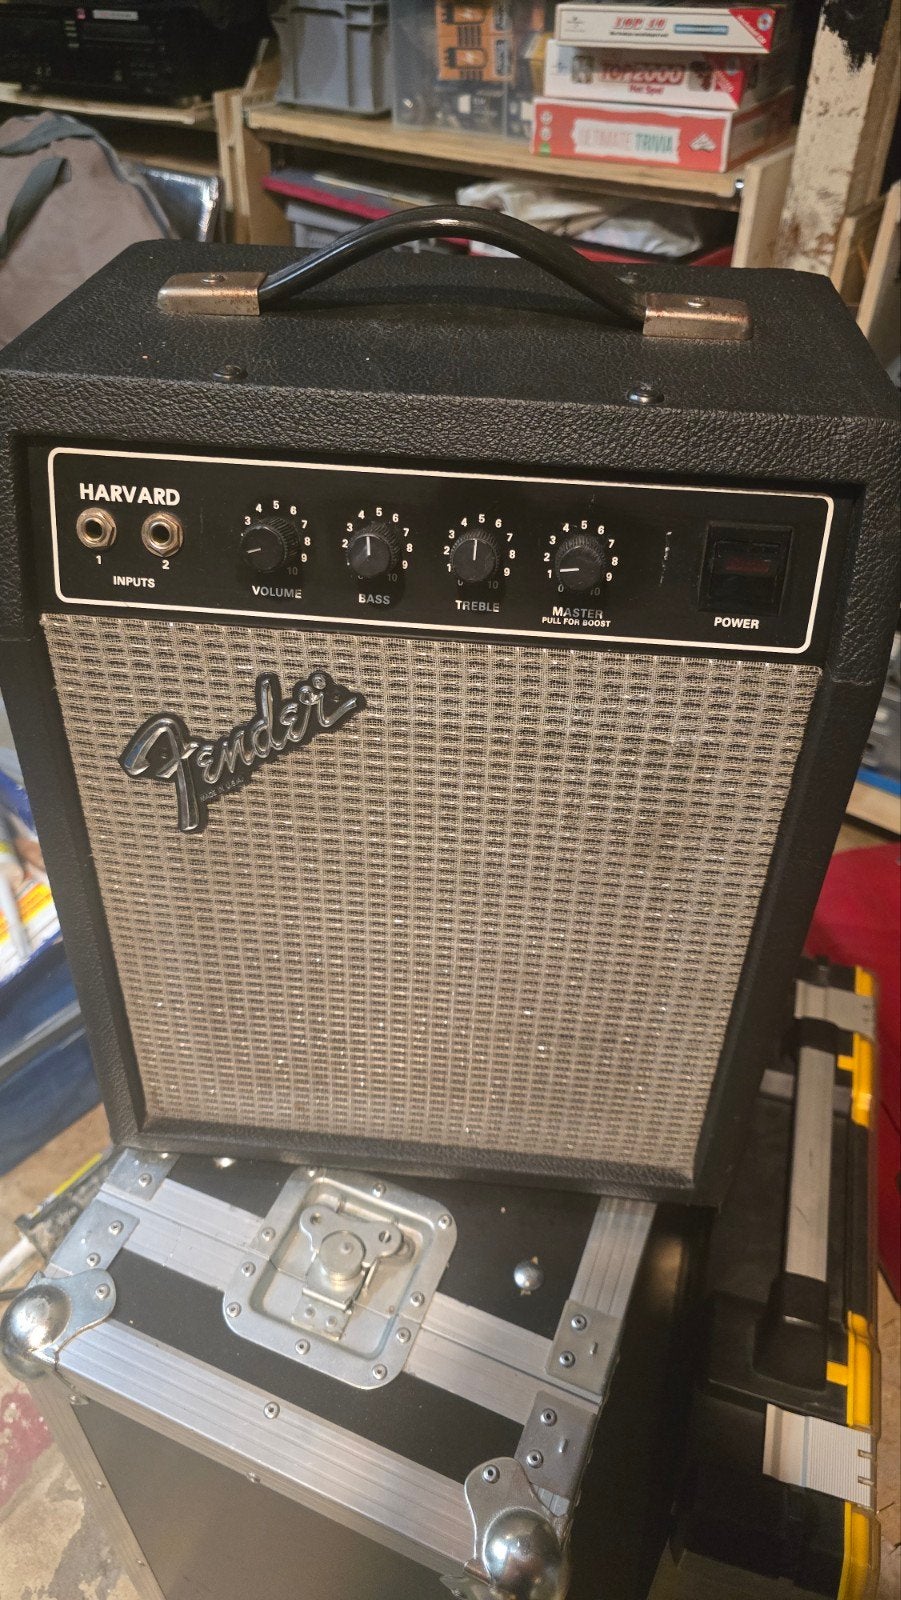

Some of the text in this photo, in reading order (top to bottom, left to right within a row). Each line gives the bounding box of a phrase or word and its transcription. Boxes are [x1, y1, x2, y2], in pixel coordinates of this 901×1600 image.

[79, 482, 181, 506] HARVARD
[460, 517, 468, 527] 4
[478, 514, 486, 523] 5
[495, 519, 502, 529] 6
[562, 523, 570, 533] 4
[581, 520, 588, 530] 5
[448, 529, 455, 539] 3
[597, 525, 605, 535] 6
[244, 500, 311, 576] 3 4 5 6 7 8 9 10
[506, 533, 513, 542] 7
[549, 535, 557, 545] 3
[341, 507, 413, 582] 2 3 4 5 6 7 8 9 10
[608, 539, 615, 549] 7
[443, 545, 450, 555] 2
[509, 550, 516, 559] 8
[96, 555, 102, 565] 1
[543, 552, 551, 562] 2
[611, 557, 619, 566] 8
[162, 560, 170, 570] 2
[503, 567, 511, 577] 9
[547, 570, 552, 579] 1
[606, 572, 613, 582] 9
[113, 575, 156, 588] INPUTS
[488, 580, 499, 590] 10
[251, 585, 302, 599] VOLUME
[557, 583, 565, 593] 0
[358, 593, 391, 605] BASS
[455, 600, 500, 613] TREBLE
[552, 606, 603, 619] MASTER
[542, 616, 611, 628] PULL FOR BOOST
[713, 616, 760, 630] POWER
[119, 671, 365, 831] Fender
